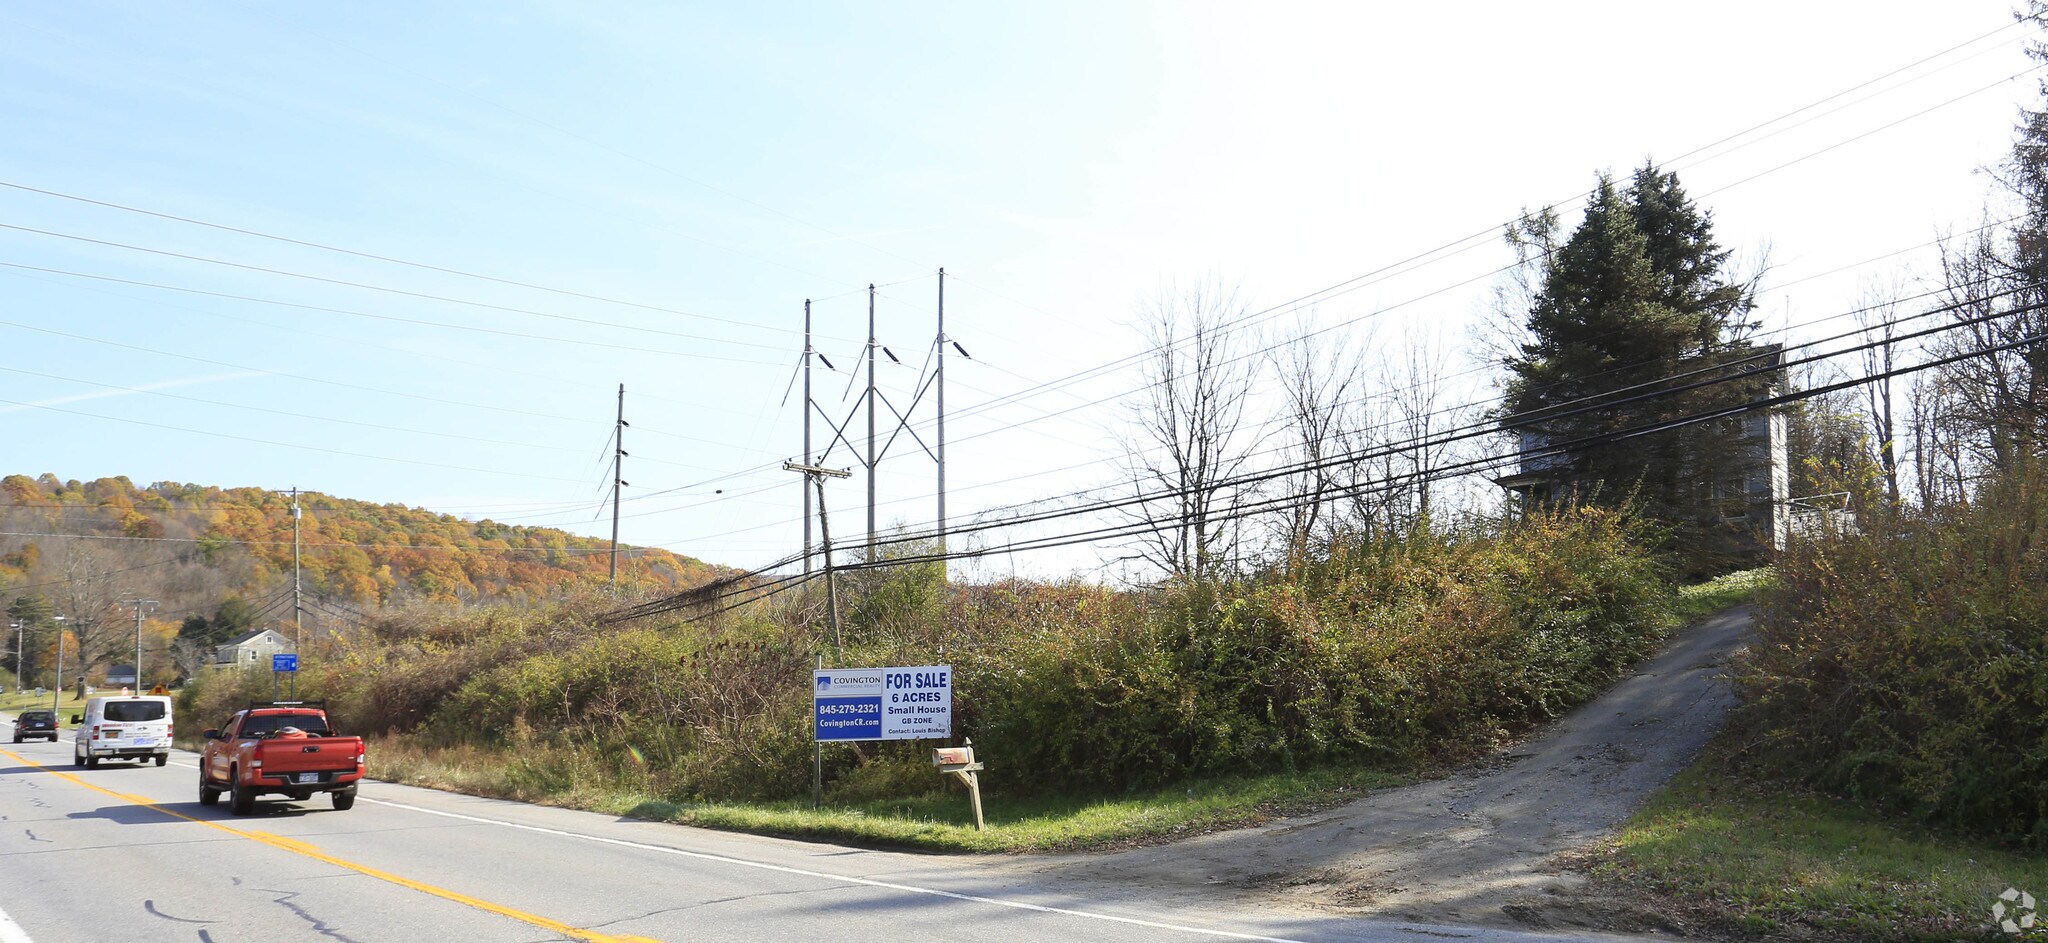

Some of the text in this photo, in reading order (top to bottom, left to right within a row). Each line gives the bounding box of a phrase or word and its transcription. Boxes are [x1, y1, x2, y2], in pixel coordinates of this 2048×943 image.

[834, 676, 881, 685] COVINGTON
[886, 672, 947, 689] FOR SALE
[892, 692, 941, 703] 6 ACRES
[820, 704, 879, 714] 845-279-2321
[888, 705, 946, 715] Small House
[820, 718, 879, 728] CovingtonCR.com
